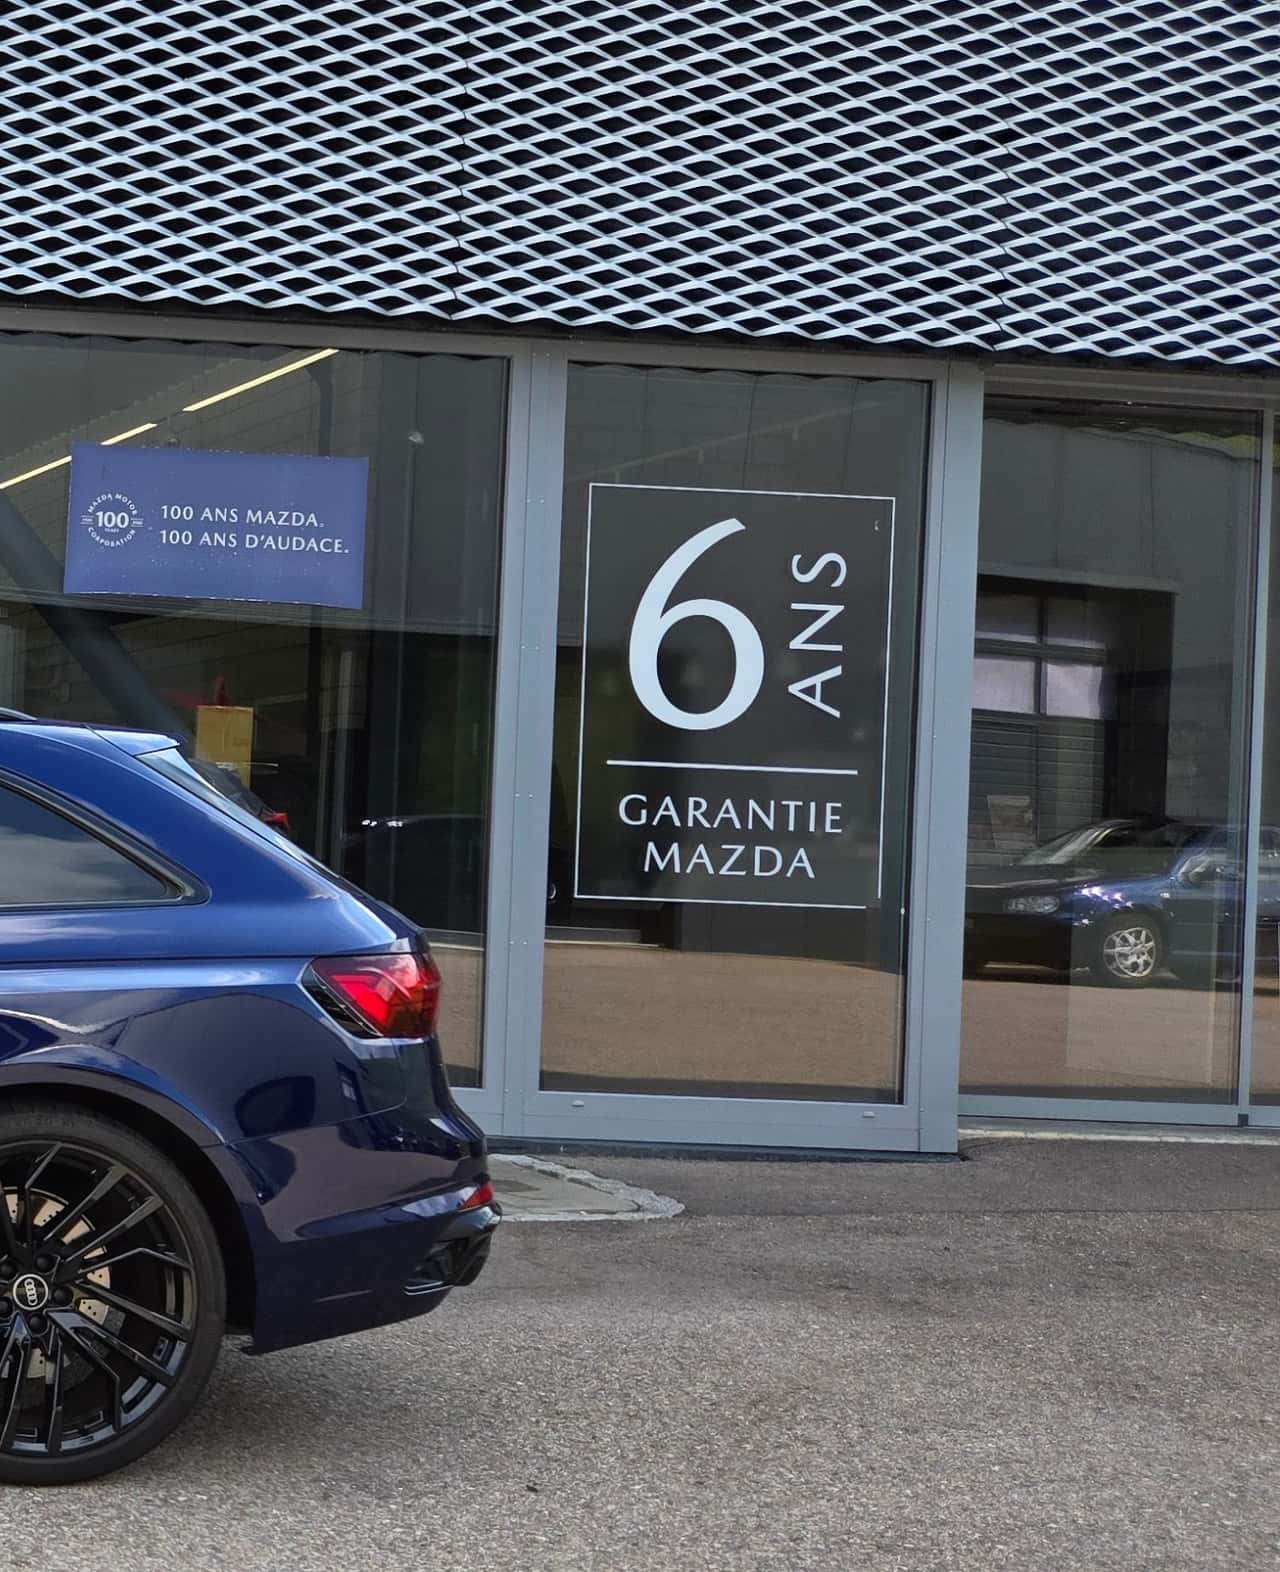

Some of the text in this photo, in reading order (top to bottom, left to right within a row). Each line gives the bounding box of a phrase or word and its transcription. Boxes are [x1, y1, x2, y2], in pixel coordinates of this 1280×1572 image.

[95, 511, 130, 528] 100
[160, 505, 325, 528] 100 ANS MAZDA.
[159, 529, 350, 555] 100 ANS D'AUDACE.
[628, 517, 765, 731] 6
[788, 552, 847, 719] ANS
[618, 793, 843, 834] GARANTIE
[643, 841, 816, 879] MAZDA
